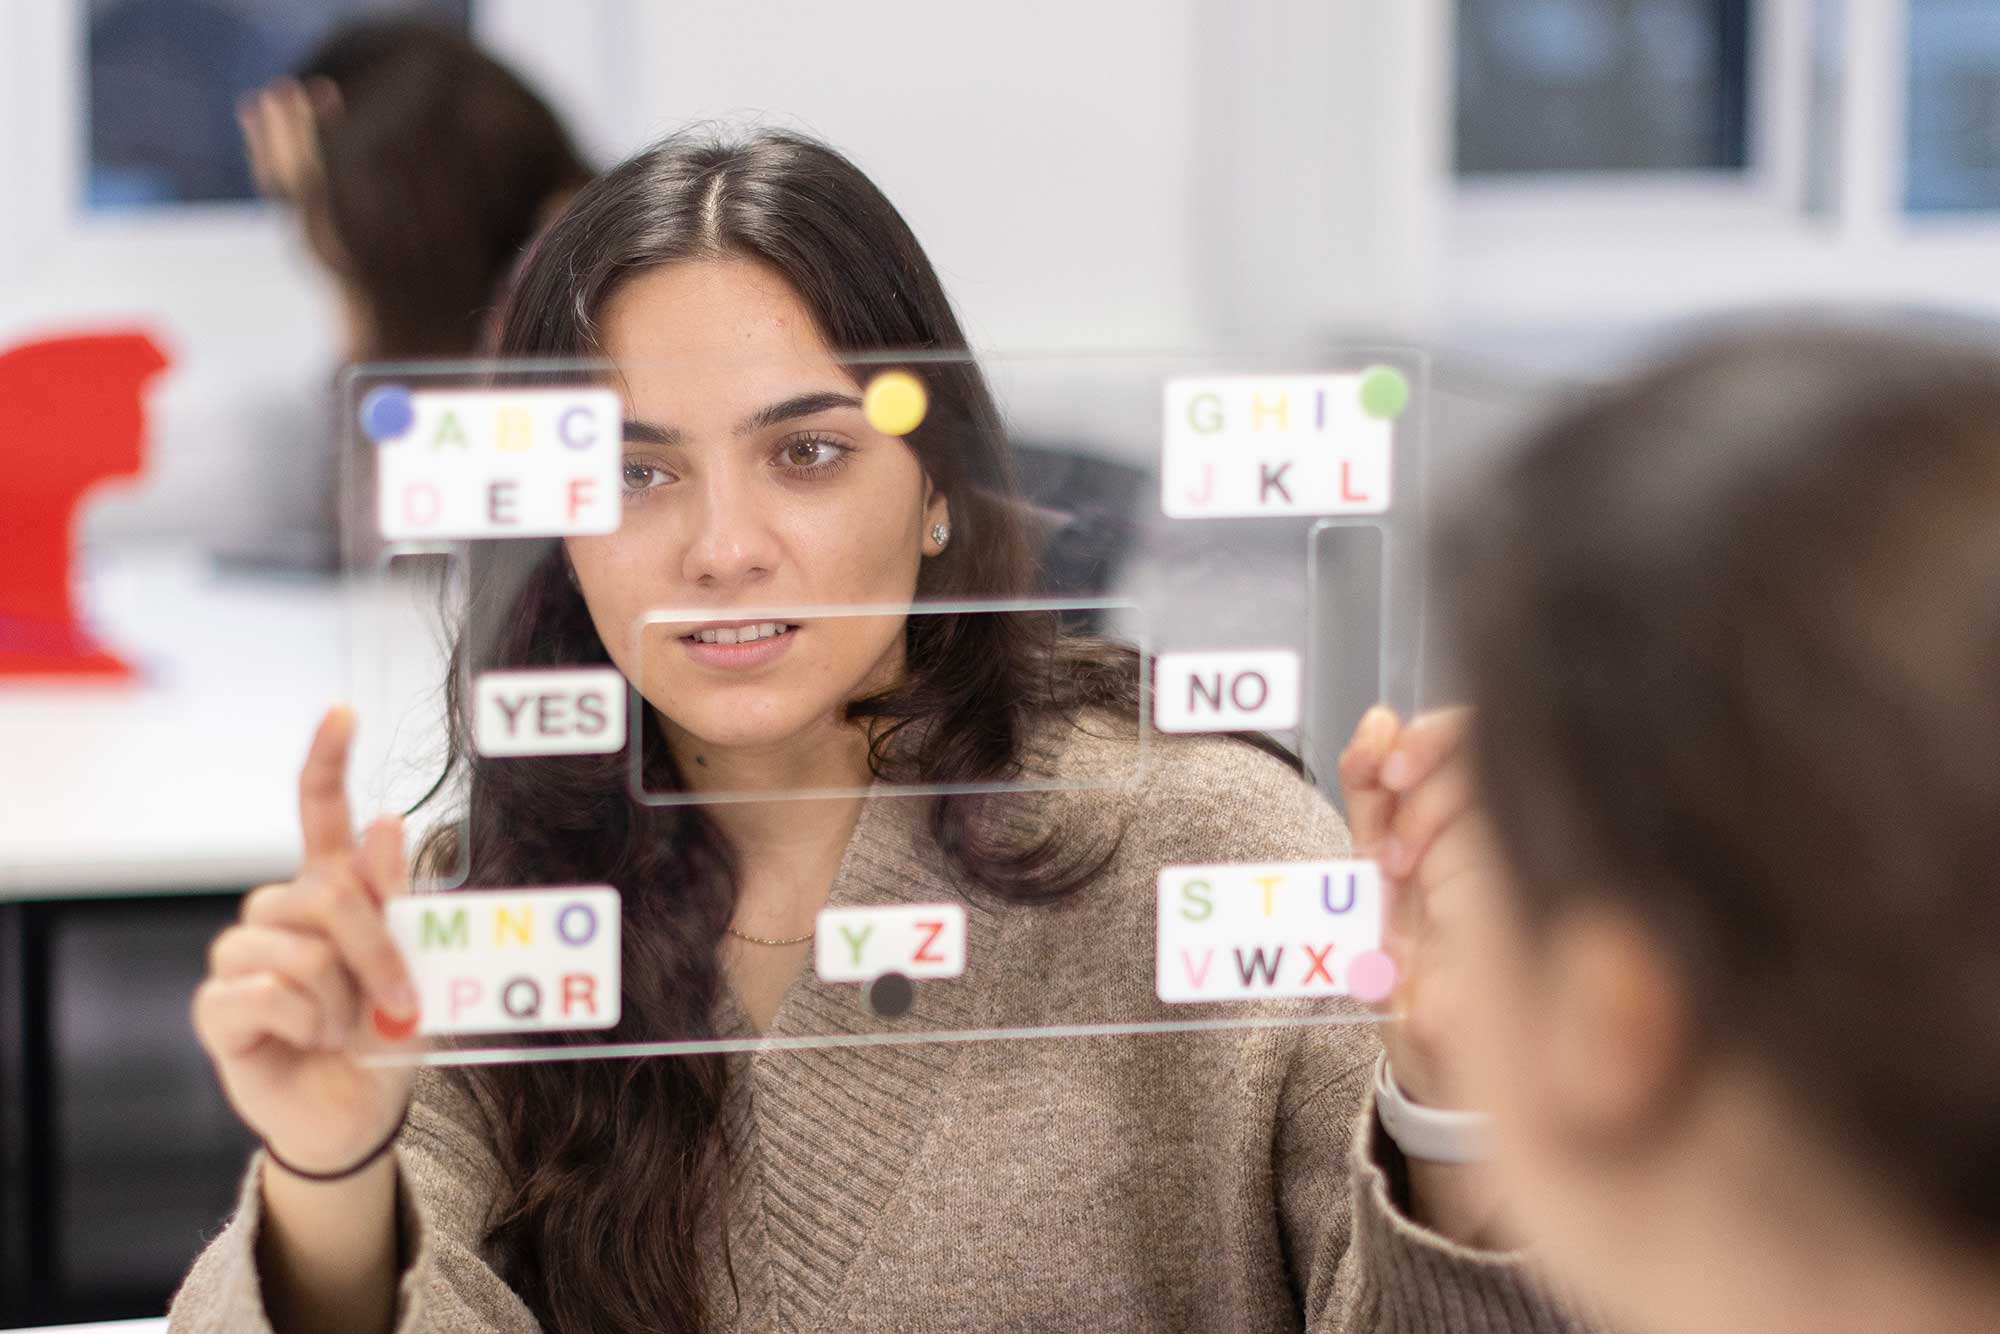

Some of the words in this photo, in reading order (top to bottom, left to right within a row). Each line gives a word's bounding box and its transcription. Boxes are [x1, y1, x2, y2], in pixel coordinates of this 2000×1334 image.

[433, 409, 468, 449] A
[557, 403, 597, 450] C
[1186, 392, 1226, 435] G
[1249, 389, 1291, 433] H
[1314, 387, 1326, 430] I
[404, 482, 443, 528] D
[485, 477, 522, 525] E
[566, 477, 598, 521] F
[1184, 462, 1214, 504] J
[1259, 460, 1293, 504] K
[1338, 459, 1369, 502] L
[495, 693, 608, 735] YES
[1187, 671, 1268, 713] NO
[1180, 877, 1214, 923] S
[1254, 875, 1284, 917] T
[1321, 873, 1356, 915] U
[421, 907, 469, 950] M
[495, 905, 534, 949] N
[557, 901, 598, 947] O
[839, 924, 875, 965] Y
[912, 922, 945, 965] Z
[1181, 947, 1213, 990] V
[1233, 945, 1284, 988] W
[1302, 943, 1334, 985] X
[448, 977, 483, 1023] P
[502, 976, 542, 1019] Q
[560, 973, 598, 1017] R
